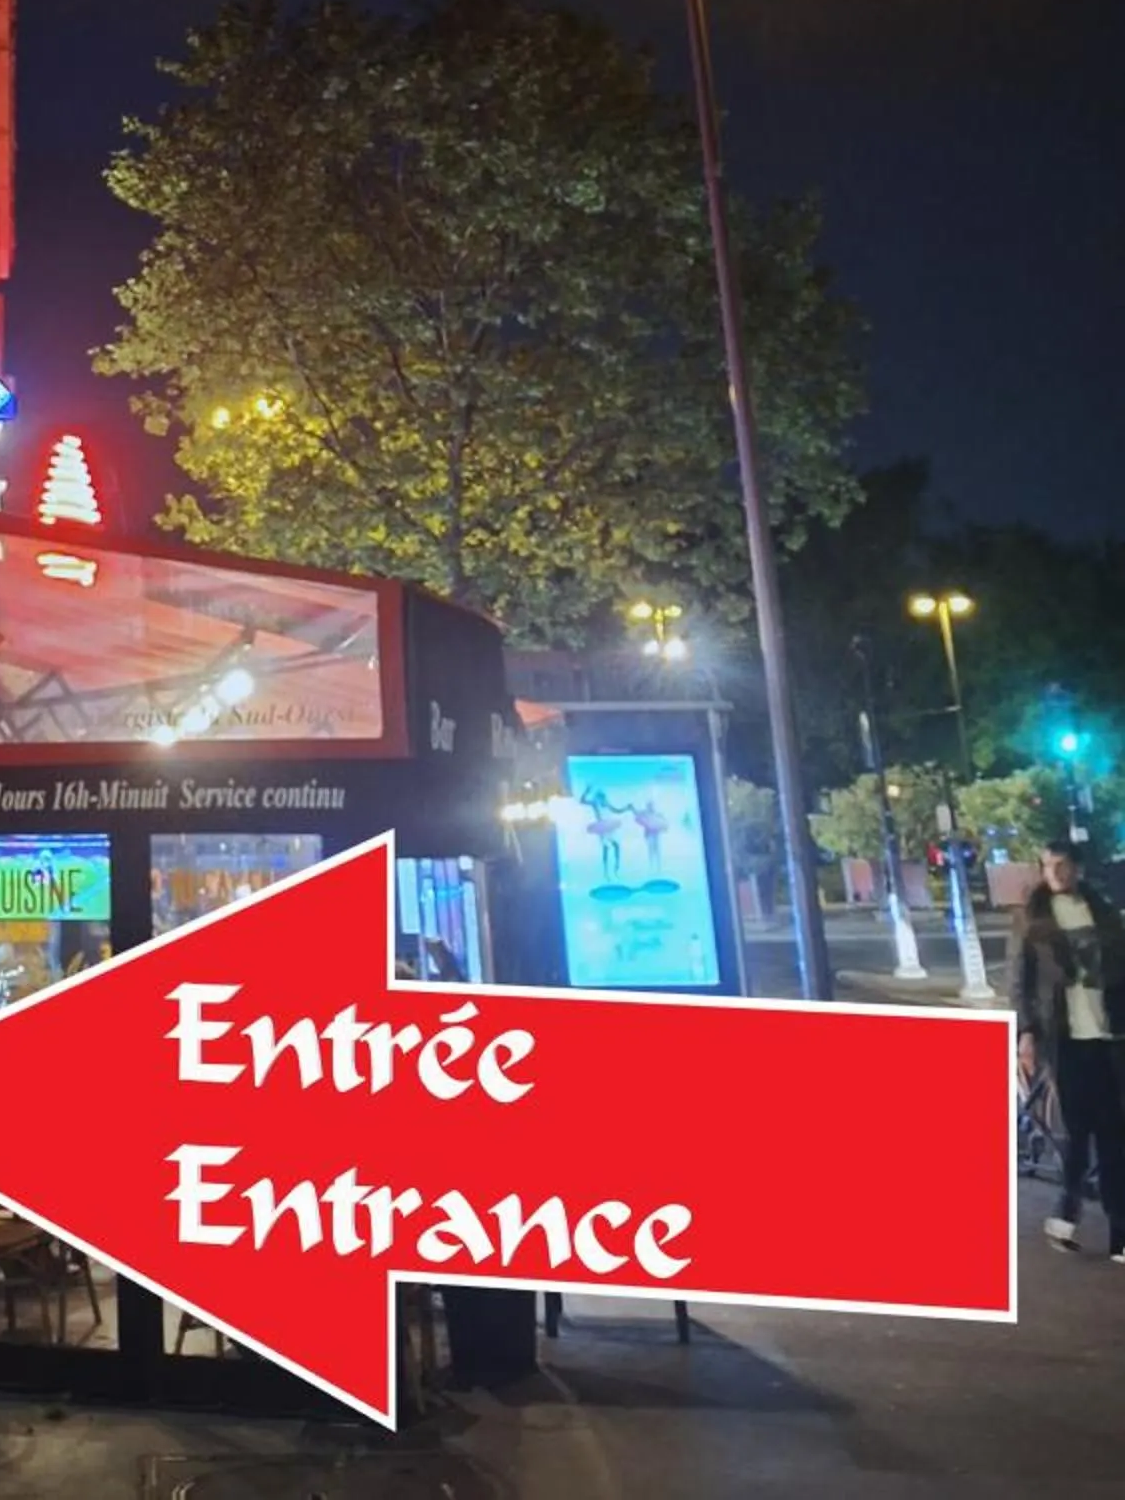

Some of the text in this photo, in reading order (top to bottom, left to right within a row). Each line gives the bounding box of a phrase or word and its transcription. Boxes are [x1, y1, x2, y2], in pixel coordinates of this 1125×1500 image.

[52, 778, 170, 811] 16h-Minuit
[179, 778, 257, 809] Service
[261, 778, 346, 809] continu
